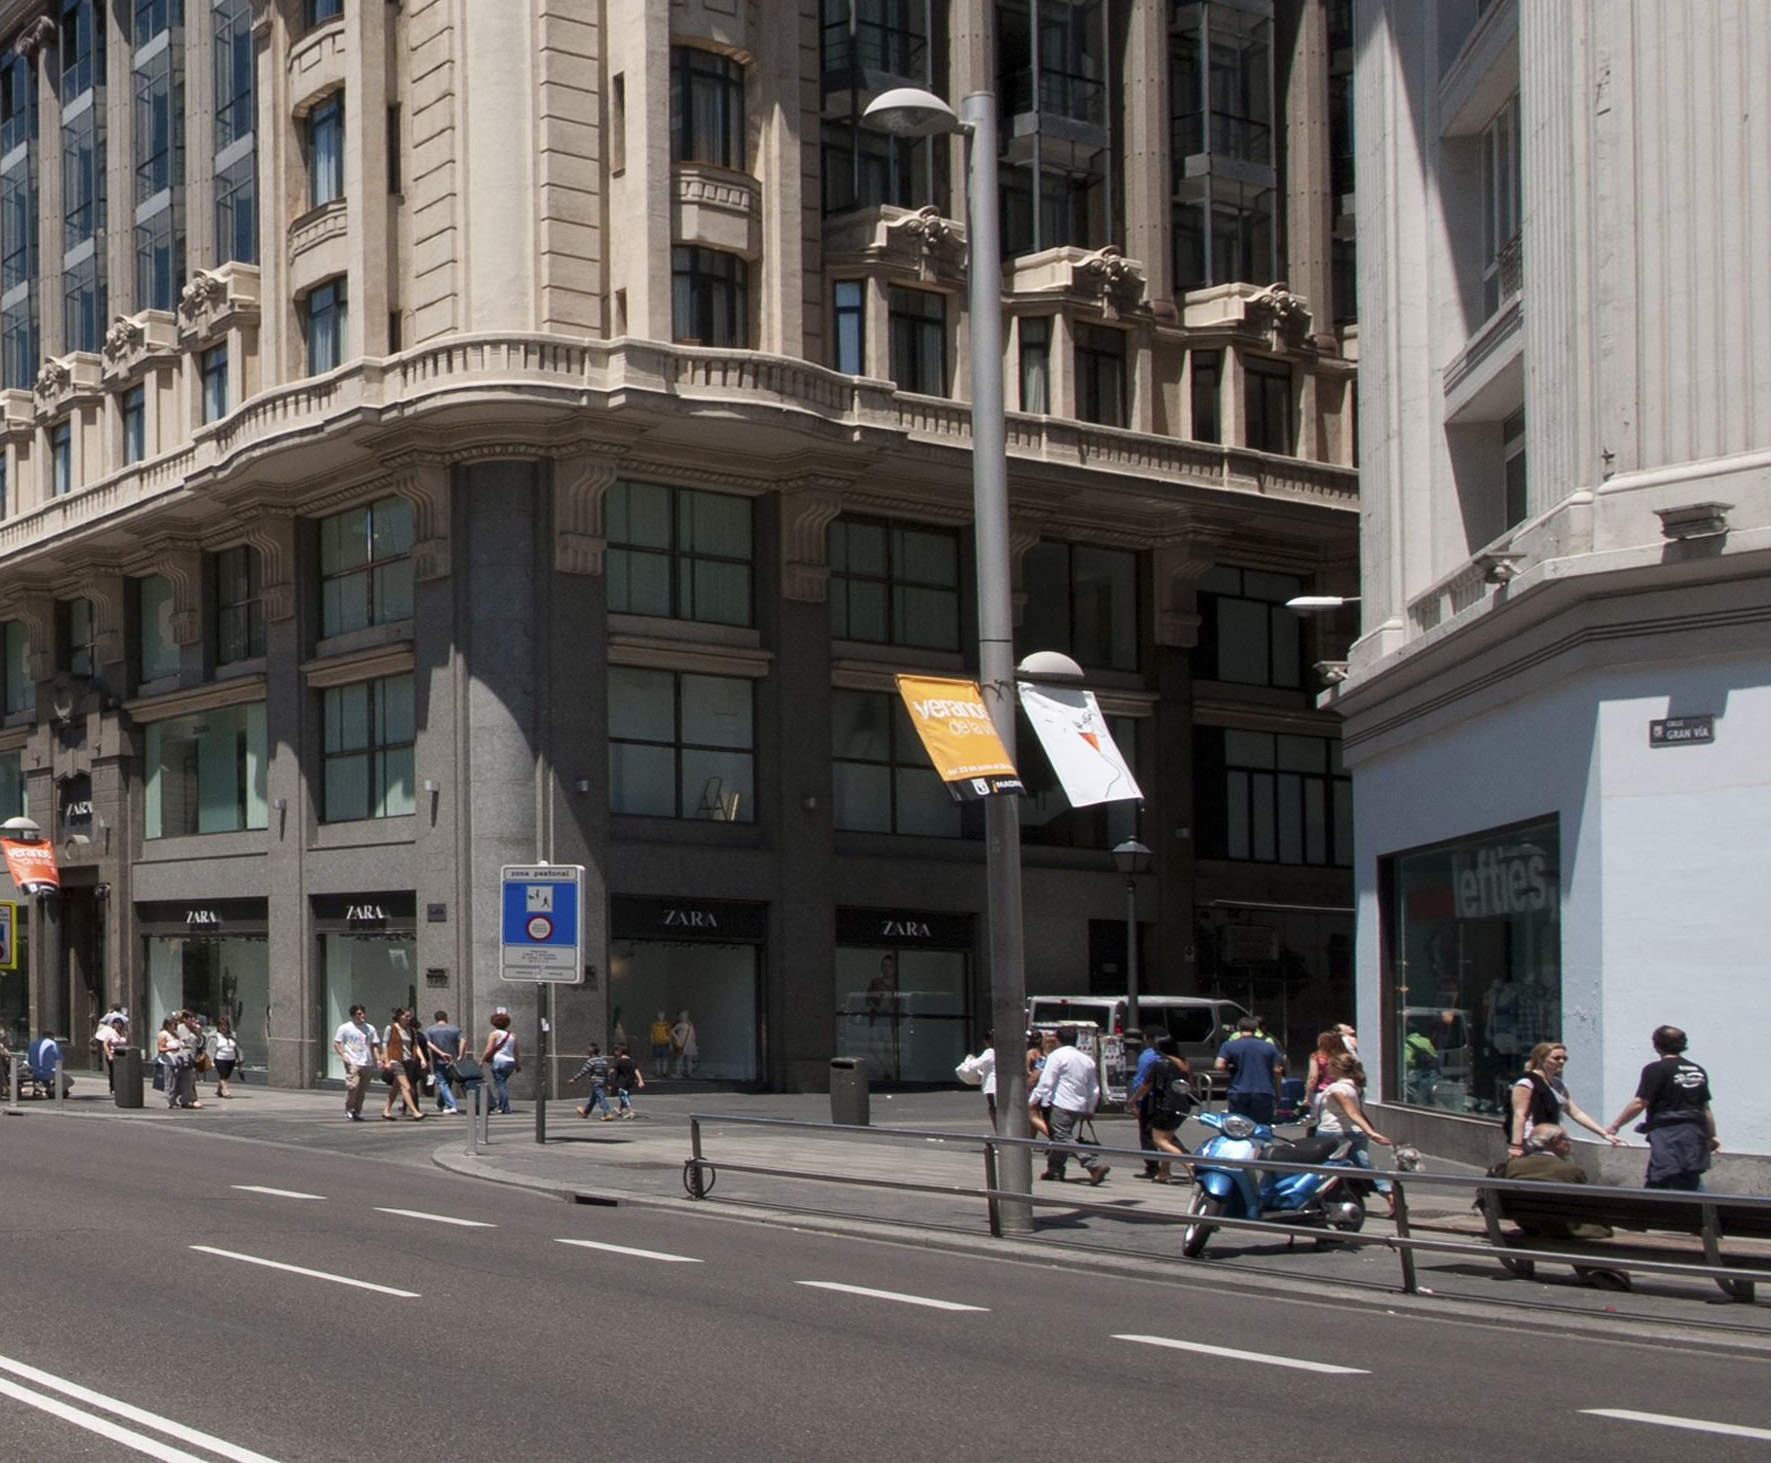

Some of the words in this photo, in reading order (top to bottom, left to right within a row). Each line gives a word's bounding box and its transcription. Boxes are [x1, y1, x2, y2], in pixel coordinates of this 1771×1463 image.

[1666, 728, 1692, 740] GRAN
[1693, 725, 1709, 738] VÍA
[534, 869, 569, 878] peatonal
[186, 910, 217, 924] ZARA
[346, 905, 385, 920] ZARA
[663, 909, 718, 927] ZARA
[882, 920, 932, 937] ZARA
